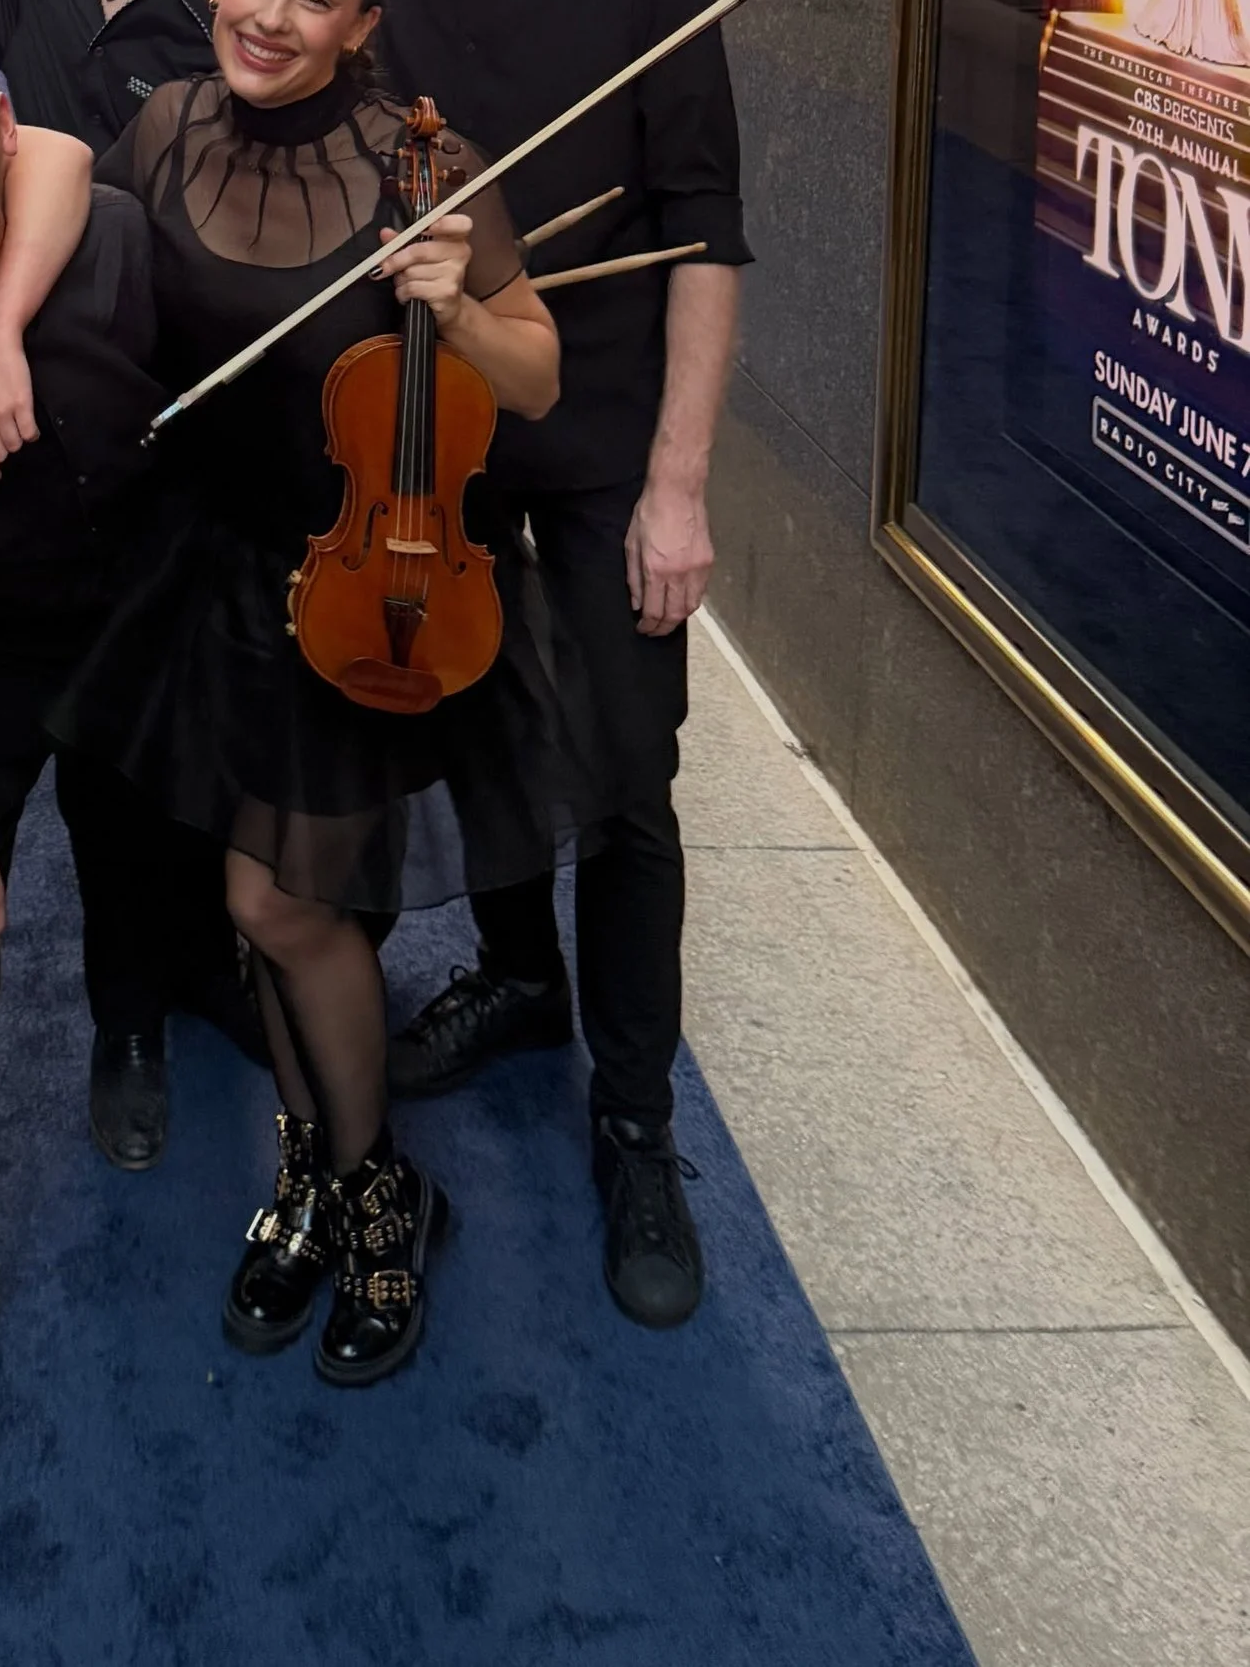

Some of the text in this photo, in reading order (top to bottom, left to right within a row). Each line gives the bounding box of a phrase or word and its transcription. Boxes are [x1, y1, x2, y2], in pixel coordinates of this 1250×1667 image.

[1083, 45, 1239, 112] THE AMERICAN THEATRE
[1127, 114, 1242, 183] 79TH ANNUAL
[1133, 87, 1236, 143] CBS PRESENTS
[1132, 308, 1220, 373] AWARDS
[1094, 350, 1177, 426] SUNDAY
[1178, 406, 1238, 469] JUNE
[1100, 417, 1208, 503] RADIO CITY
